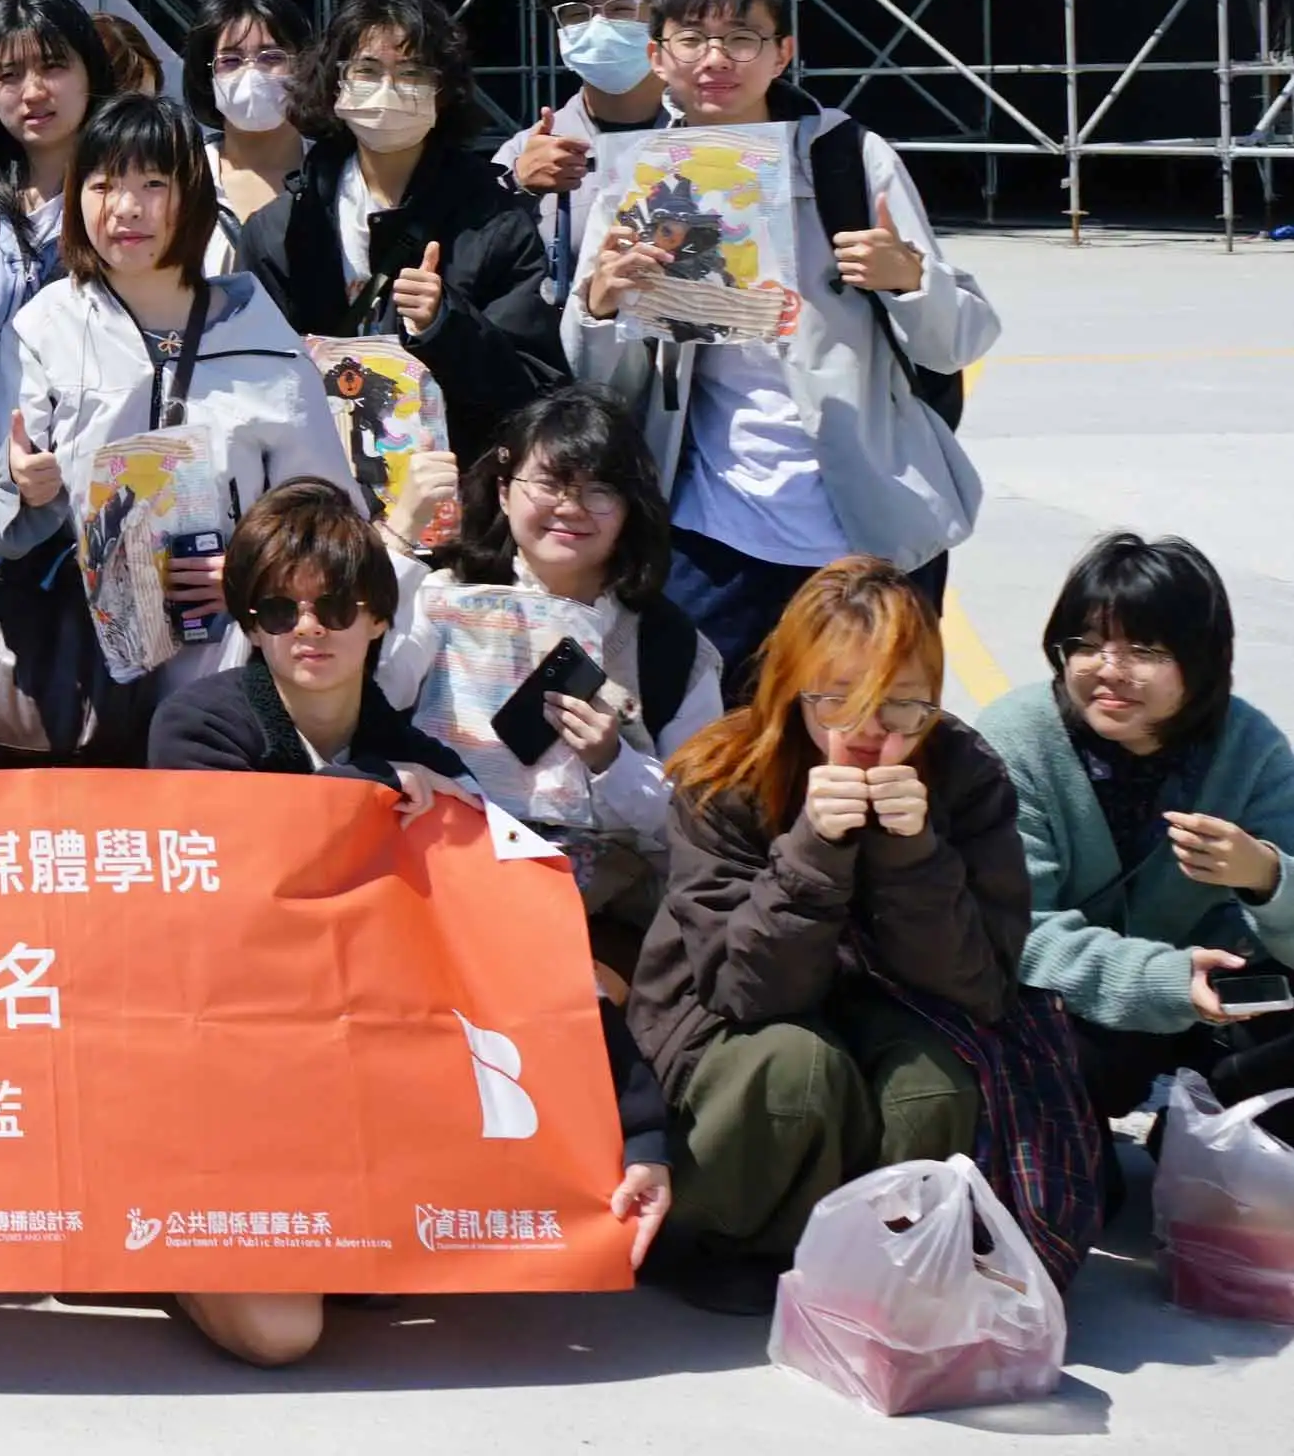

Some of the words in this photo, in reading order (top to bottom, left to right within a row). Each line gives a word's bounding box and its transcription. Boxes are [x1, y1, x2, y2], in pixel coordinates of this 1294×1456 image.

[166, 1210, 333, 1235] 公共關係暨廣告系
[434, 1208, 563, 1240] 資訊傳播系
